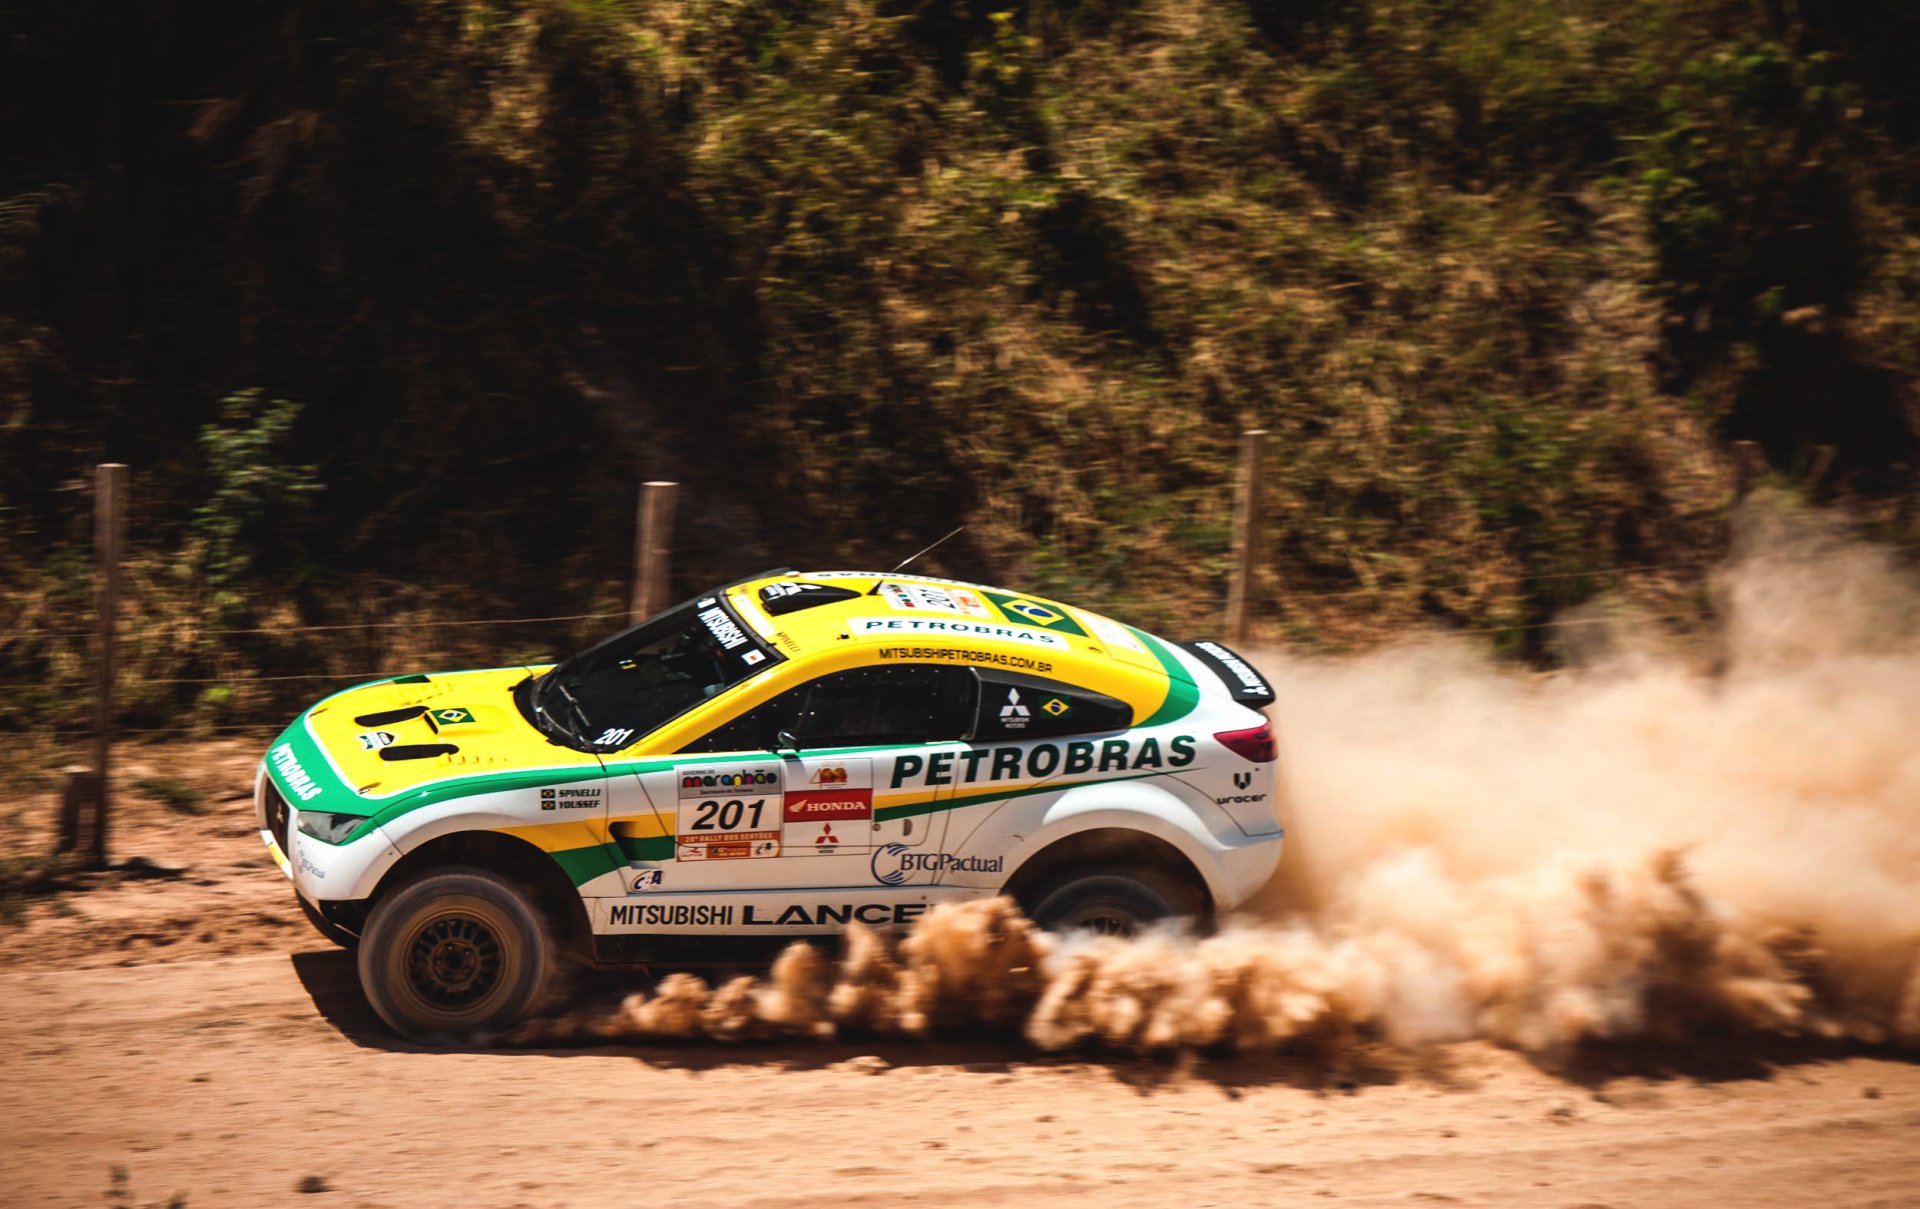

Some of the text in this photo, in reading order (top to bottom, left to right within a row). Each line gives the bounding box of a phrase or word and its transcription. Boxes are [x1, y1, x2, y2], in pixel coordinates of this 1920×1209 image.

[697, 606, 748, 650] MITSUBISHI
[865, 620, 1055, 643] PETROBRAS
[879, 648, 1053, 674] MITSUBISHIPETROBRAS.COM.BR
[593, 727, 635, 746] 201
[271, 742, 323, 801] PETROBRAS
[890, 735, 1197, 788] PETROBRAS
[682, 768, 777, 788] maranhão
[558, 788, 601, 798] SPINELLI
[558, 800, 600, 809] YOUSSEF
[691, 799, 766, 830] 201
[806, 801, 867, 812] HONDA
[609, 903, 937, 926] MITSUBISHI LANCE
